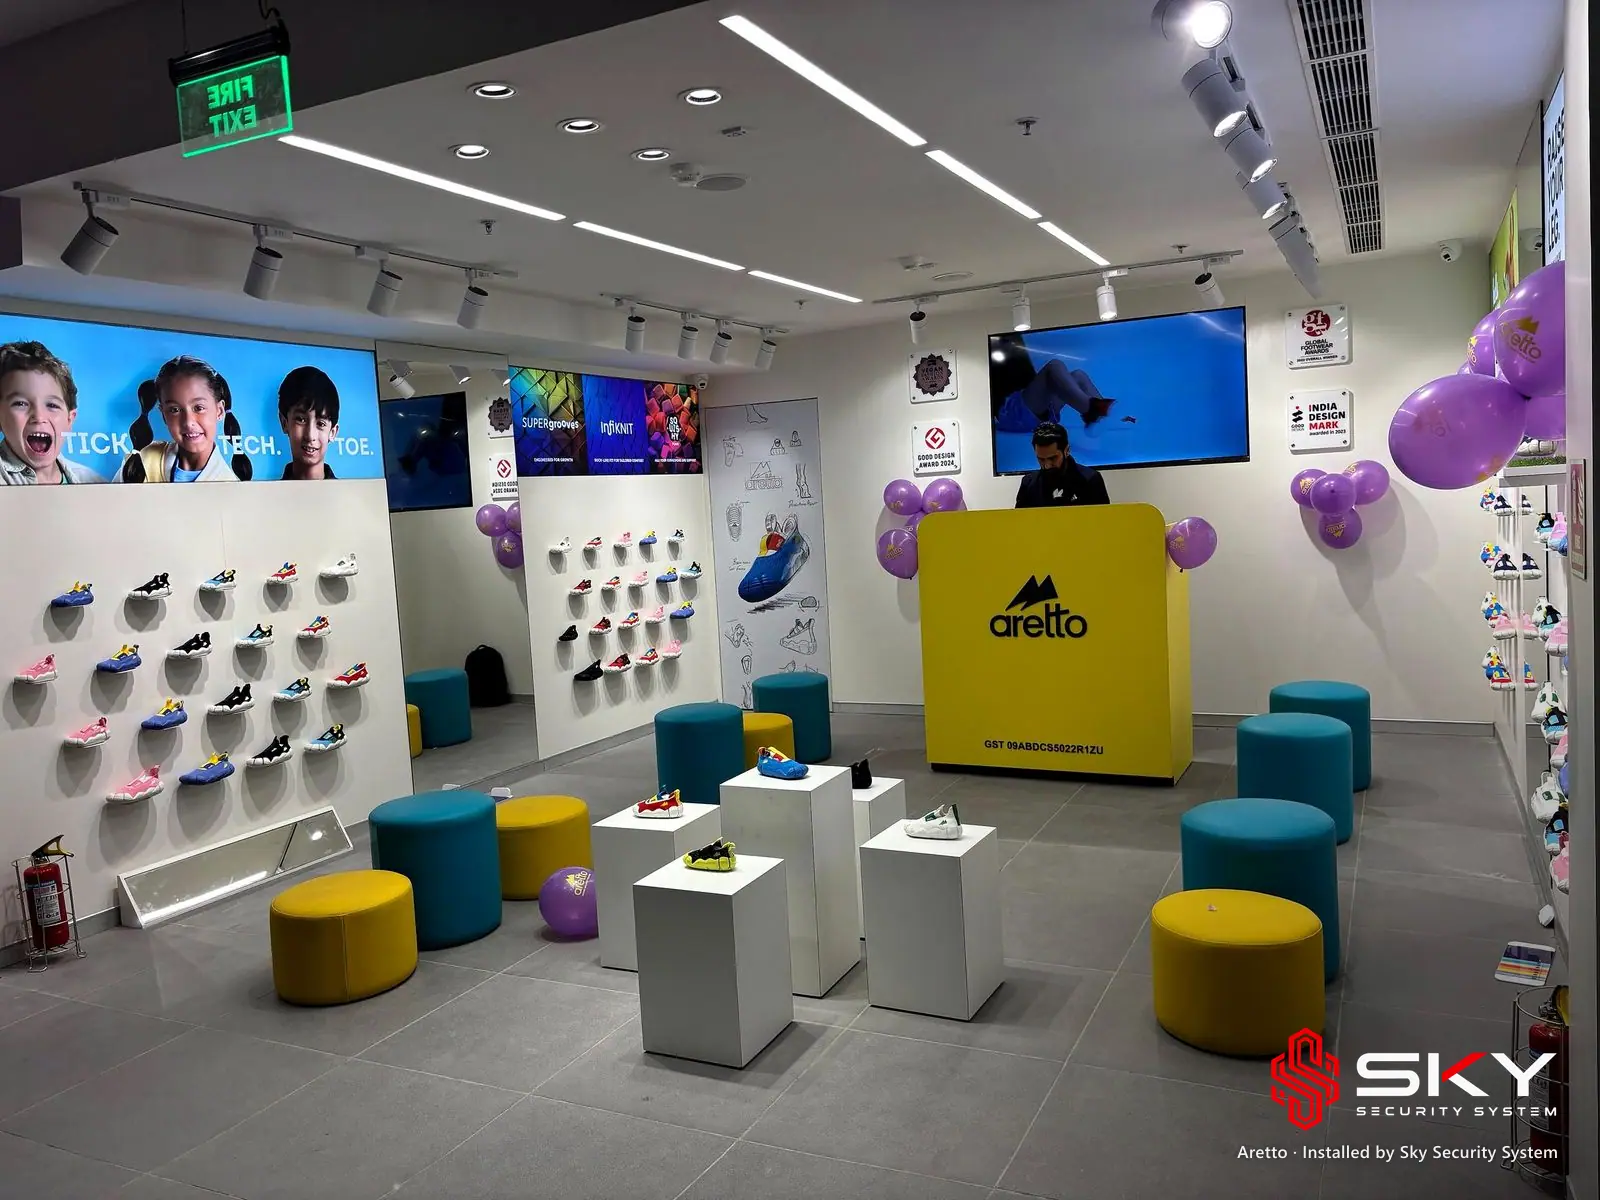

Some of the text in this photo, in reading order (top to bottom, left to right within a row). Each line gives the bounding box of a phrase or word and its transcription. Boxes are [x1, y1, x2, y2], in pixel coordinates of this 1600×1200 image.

[1547, 155, 1564, 213] YOUR
[1301, 343, 1333, 351] FOOTWEAR
[1305, 338, 1329, 346] GLOBAL
[1309, 402, 1338, 412] INDIA
[1309, 411, 1346, 421] DESIGN
[522, 417, 579, 431] SUPERgrooves
[1309, 421, 1339, 430] MARK
[217, 435, 282, 456] TECH.
[335, 437, 375, 456] TOE.
[934, 452, 955, 460] DESIGN
[940, 459, 954, 467] 2024
[989, 603, 1088, 638] aretto
[984, 740, 1104, 755] GST 09ABDCS5022R1ZU
